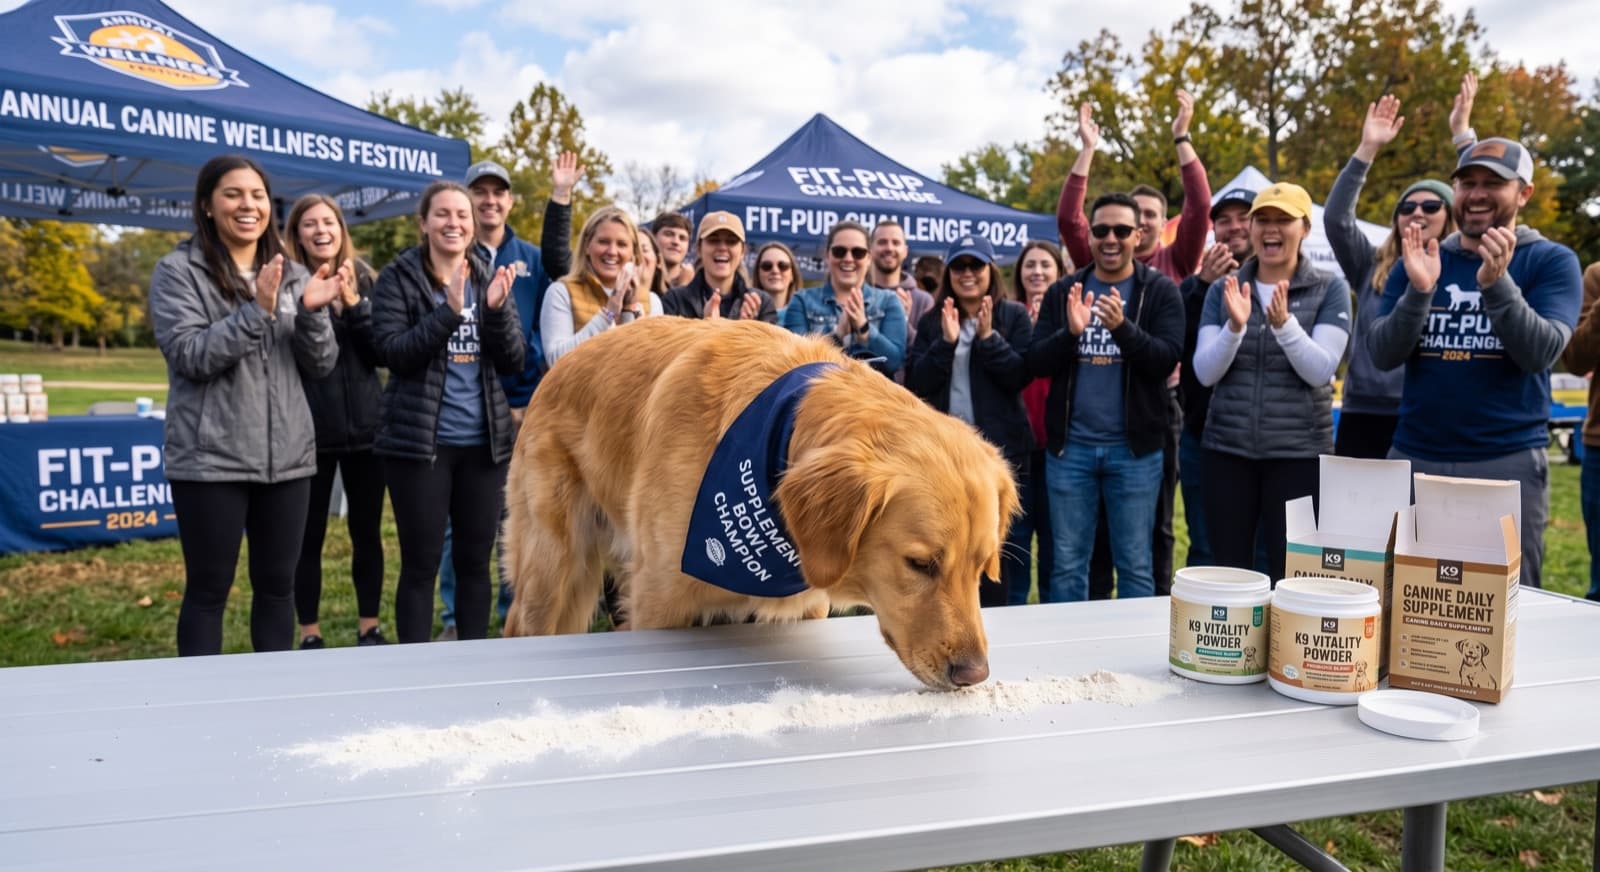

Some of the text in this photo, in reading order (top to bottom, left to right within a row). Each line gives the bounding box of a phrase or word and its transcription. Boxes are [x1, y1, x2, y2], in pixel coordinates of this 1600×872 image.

[101, 15, 176, 39] ANNUAL
[80, 44, 223, 79] WELLNESS
[0, 89, 443, 176] ANNUAL CANINE WELLNESS FESTIVAL
[787, 167, 924, 191] FIT-PUP
[800, 184, 942, 205] CHALLENGE
[746, 206, 839, 236] FIT-PUP
[977, 221, 1029, 247] 2024
[1423, 313, 1493, 334] IT-PU
[1441, 350, 1471, 361] 2024
[38, 445, 166, 486] FIT-P
[39, 483, 173, 512] CHALLEN
[106, 510, 158, 529] 2024
[732, 503, 768, 557] BOWL
[714, 492, 772, 582] CHAMPION
[1325, 553, 1341, 564] K9
[1440, 565, 1458, 576] K9
[1403, 584, 1495, 607] CANINE DAILY
[1403, 599, 1494, 622] SUPPLEMENT
[1189, 619, 1250, 636] K9 VITALITY
[1323, 621, 1336, 629] K9
[1405, 617, 1490, 633] CANINE DAILY SUPPLEMENT
[1196, 634, 1241, 648] POWDER
[1295, 632, 1361, 649] K9 VITALITY
[1304, 647, 1352, 662] POWDER
